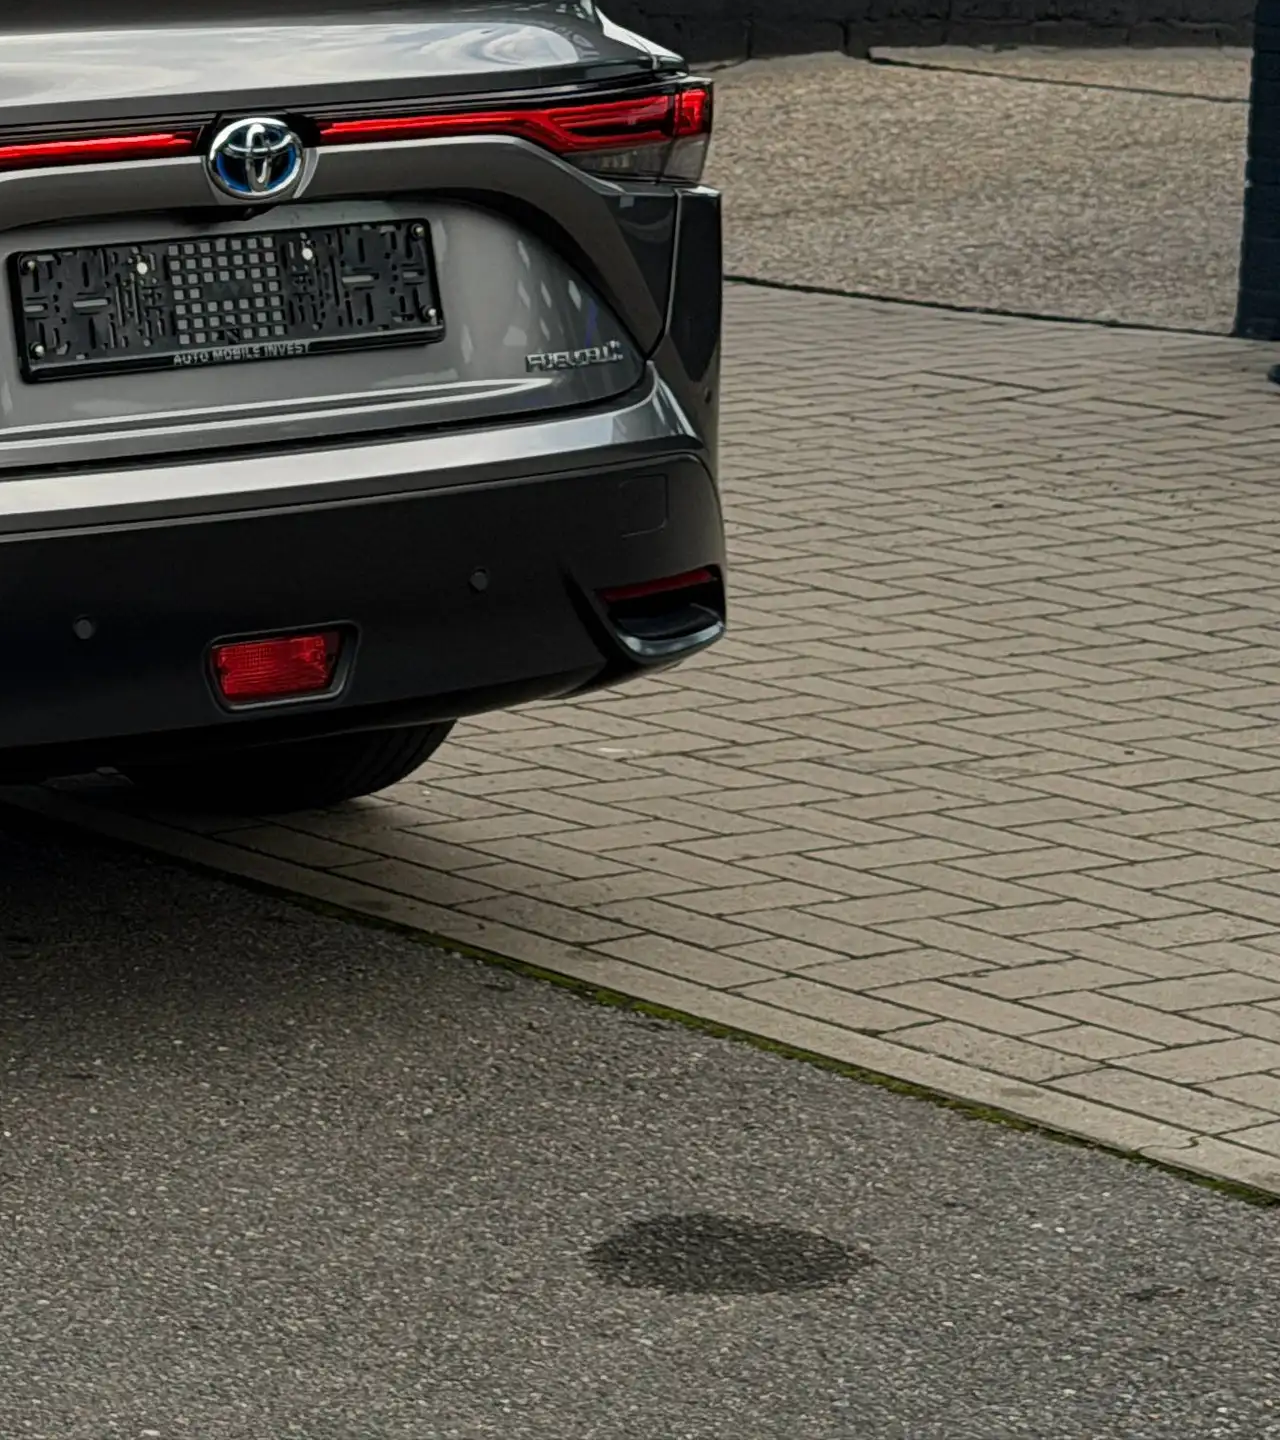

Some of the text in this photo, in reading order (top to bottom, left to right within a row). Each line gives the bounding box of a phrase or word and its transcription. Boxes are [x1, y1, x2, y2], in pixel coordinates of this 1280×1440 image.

[173, 342, 310, 366] AUTO MOBILE INVEST
